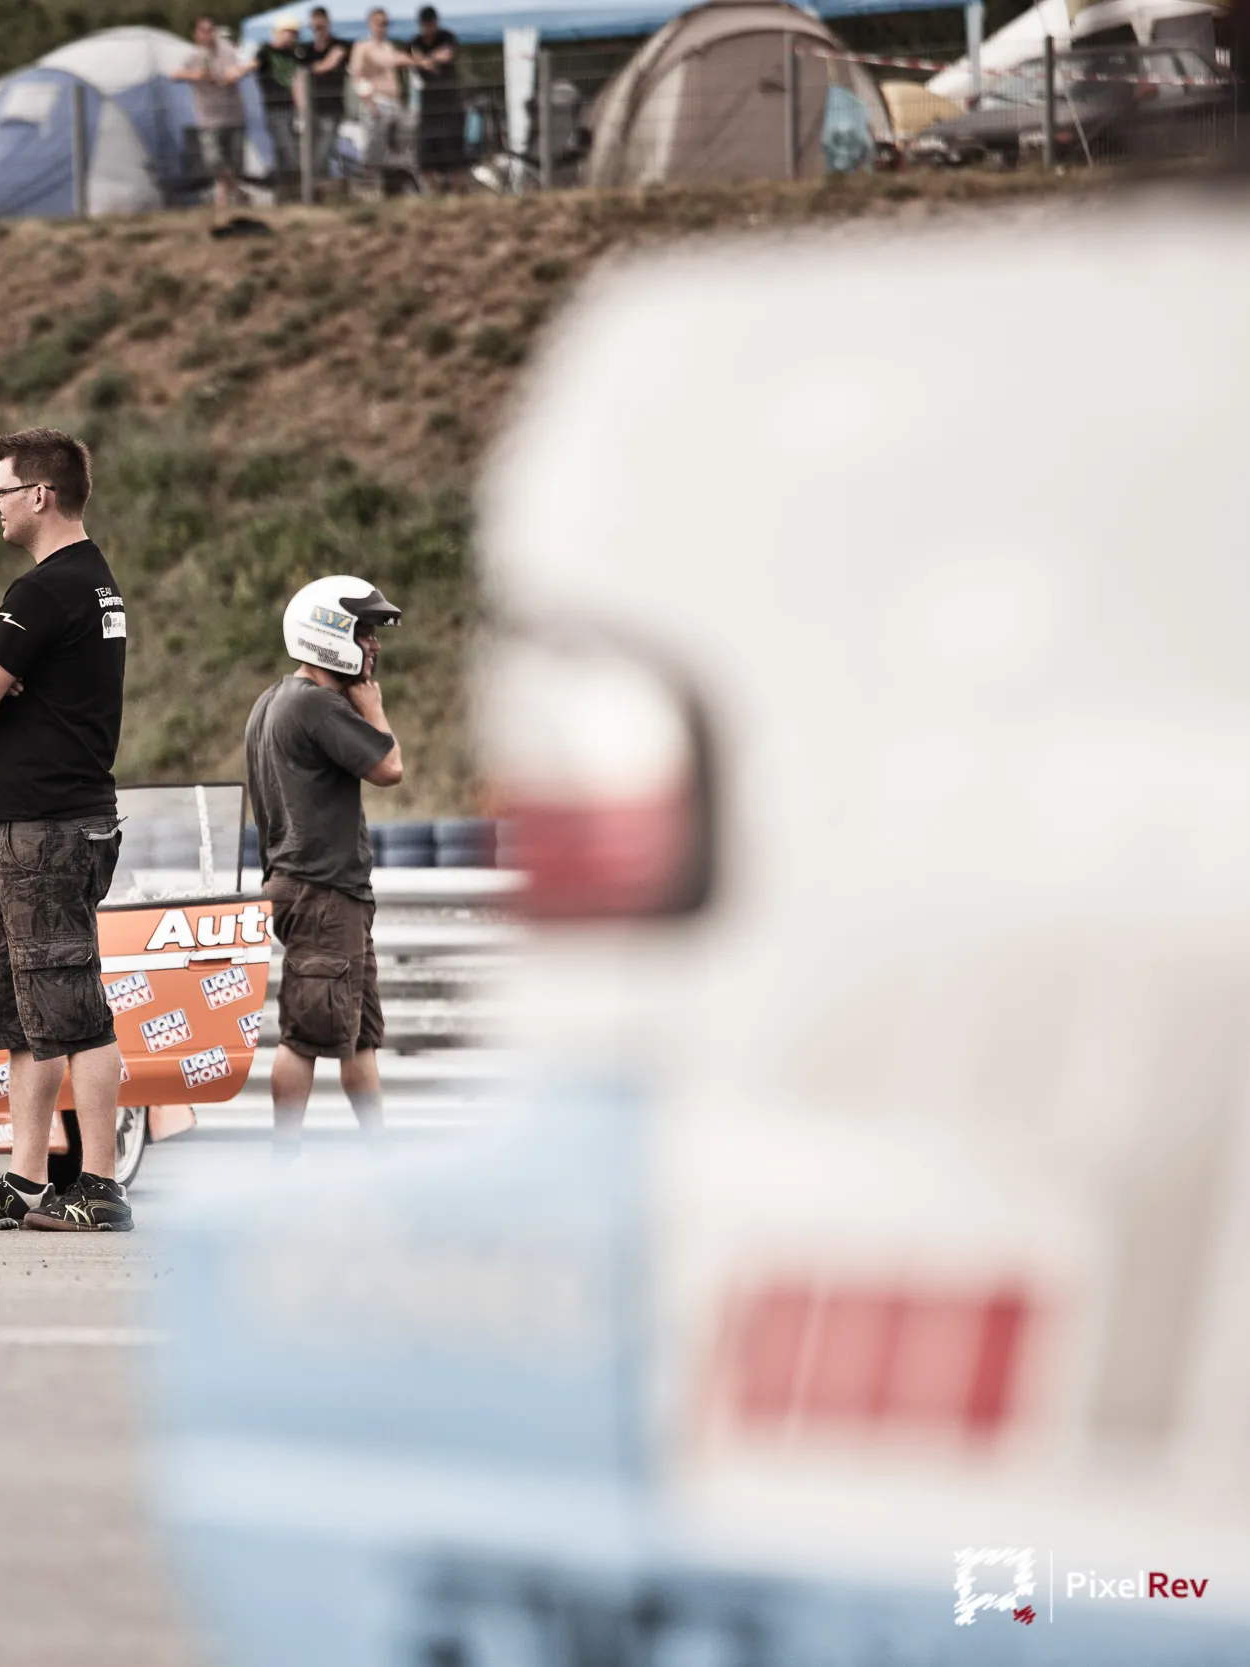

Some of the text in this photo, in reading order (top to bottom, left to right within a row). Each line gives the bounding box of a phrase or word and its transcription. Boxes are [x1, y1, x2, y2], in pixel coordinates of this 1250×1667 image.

[145, 905, 273, 951] Aut
[105, 974, 145, 998] LIQUI
[202, 968, 246, 993] LIQUI
[208, 980, 250, 1007] MOLY
[110, 987, 151, 1013] MOLY
[141, 1011, 185, 1037] LIQUI
[147, 1023, 190, 1051] MOLY
[182, 1047, 225, 1073] LIQUI
[188, 1061, 230, 1087] MOLY
